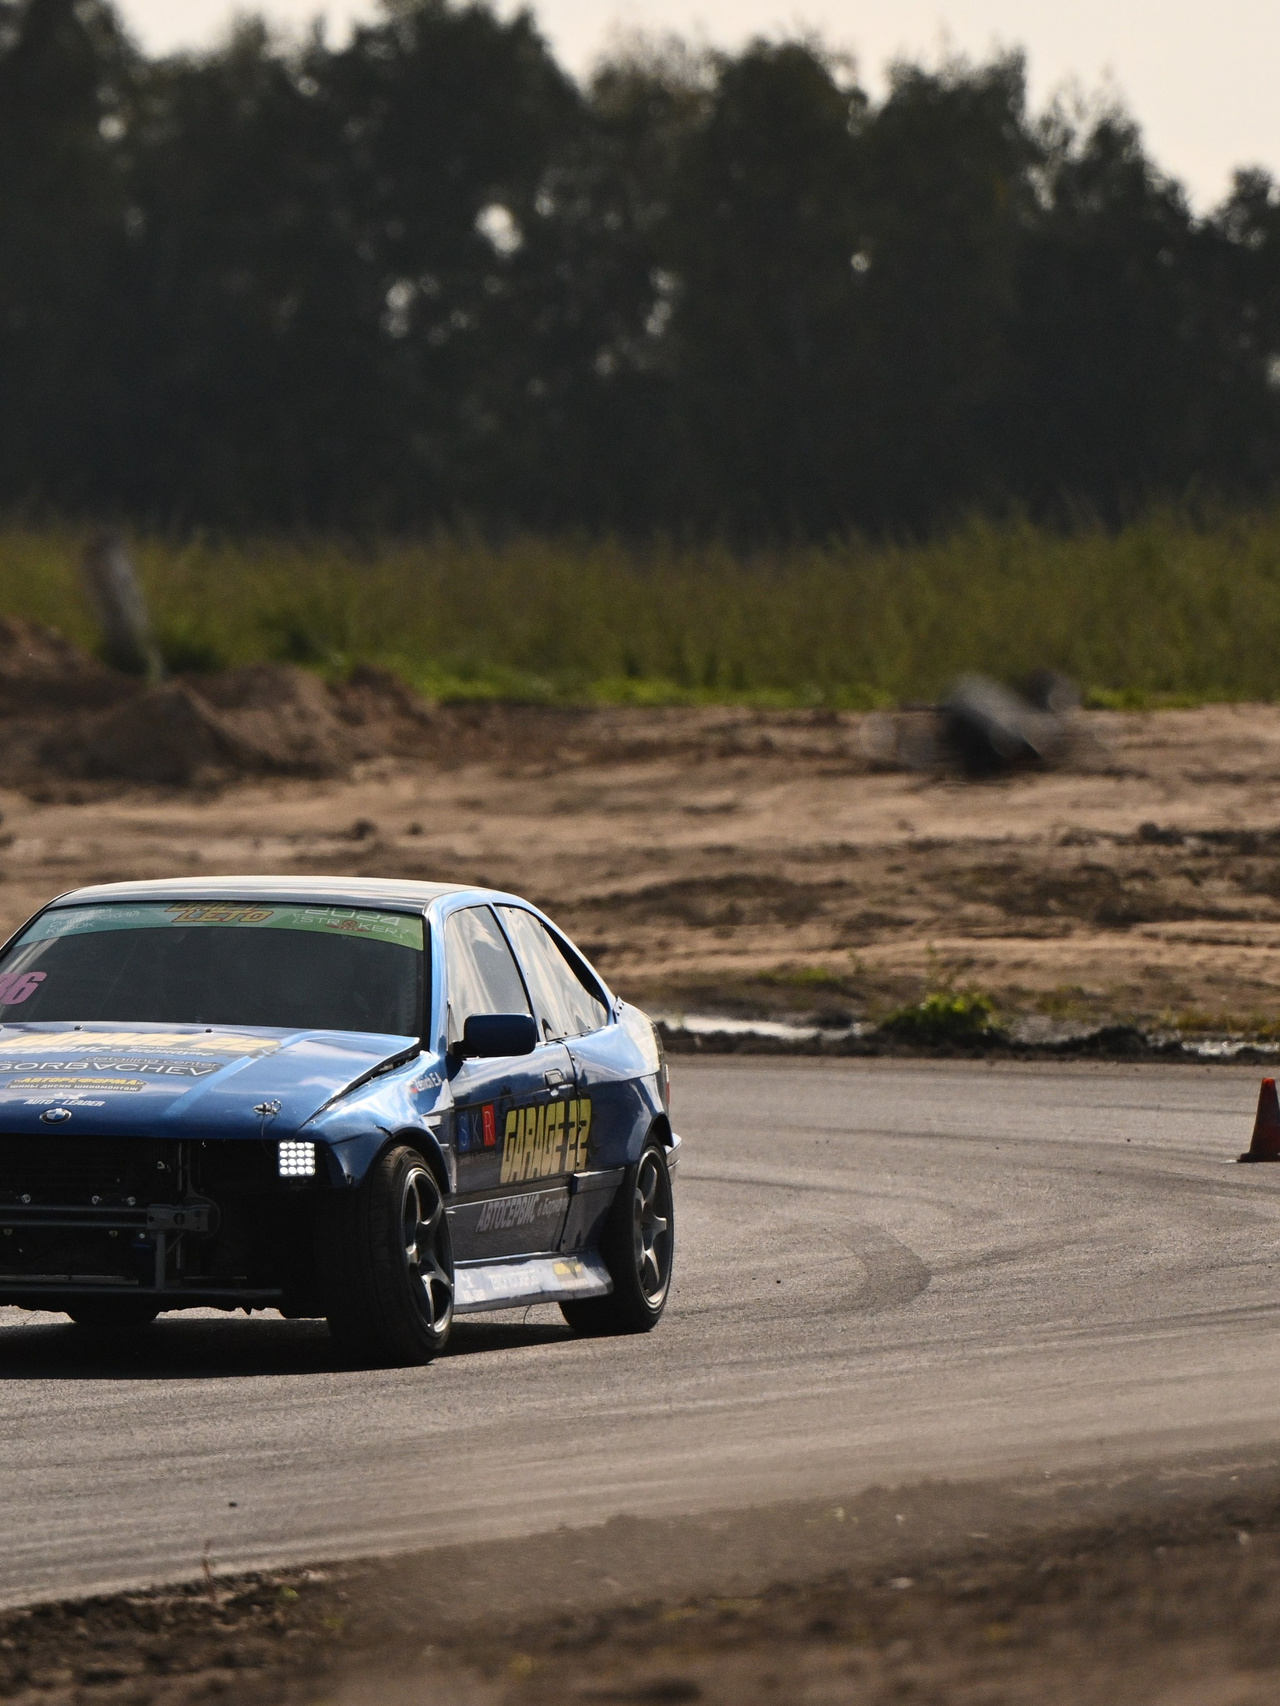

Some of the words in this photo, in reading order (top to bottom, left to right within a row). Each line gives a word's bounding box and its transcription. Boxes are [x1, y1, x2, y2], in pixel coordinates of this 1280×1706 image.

[171, 909, 274, 923] LETO
[84, 1055, 159, 1065] detailing
[163, 1058, 220, 1069] center
[61, 1099, 106, 1107] LEADER
[499, 1100, 565, 1184] GARAGE
[564, 1098, 593, 1172] 22
[475, 1193, 541, 1233] АВТОСЕРВИС
